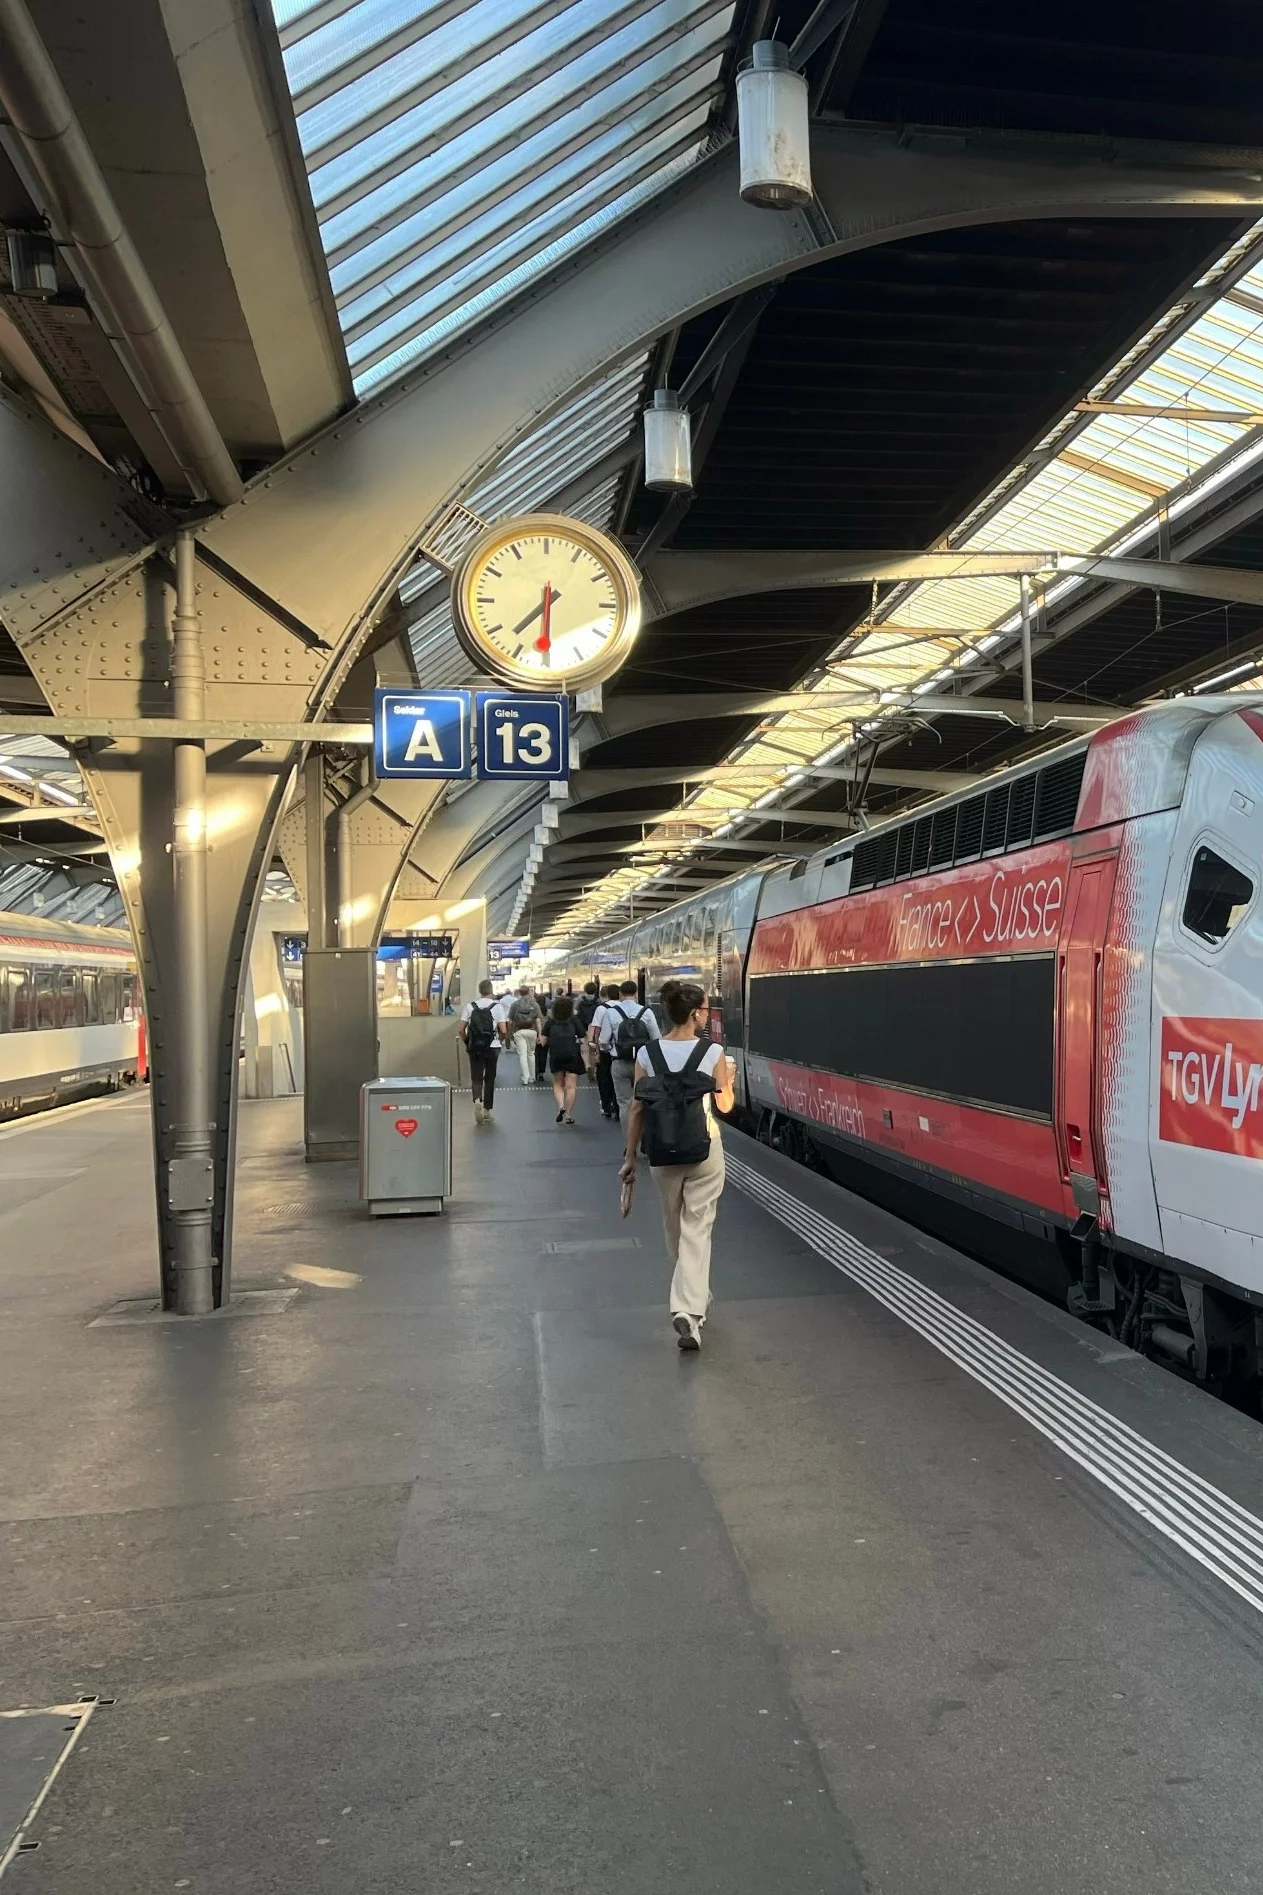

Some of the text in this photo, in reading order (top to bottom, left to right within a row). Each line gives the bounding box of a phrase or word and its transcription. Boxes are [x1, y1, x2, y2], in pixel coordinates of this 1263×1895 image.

[494, 709, 519, 718] Gleis
[404, 719, 444, 762] A
[496, 722, 552, 765] 13
[900, 892, 952, 951] France
[982, 864, 1062, 943] Suisse
[490, 951, 500, 959] 13
[818, 1087, 866, 1139] Frankreich
